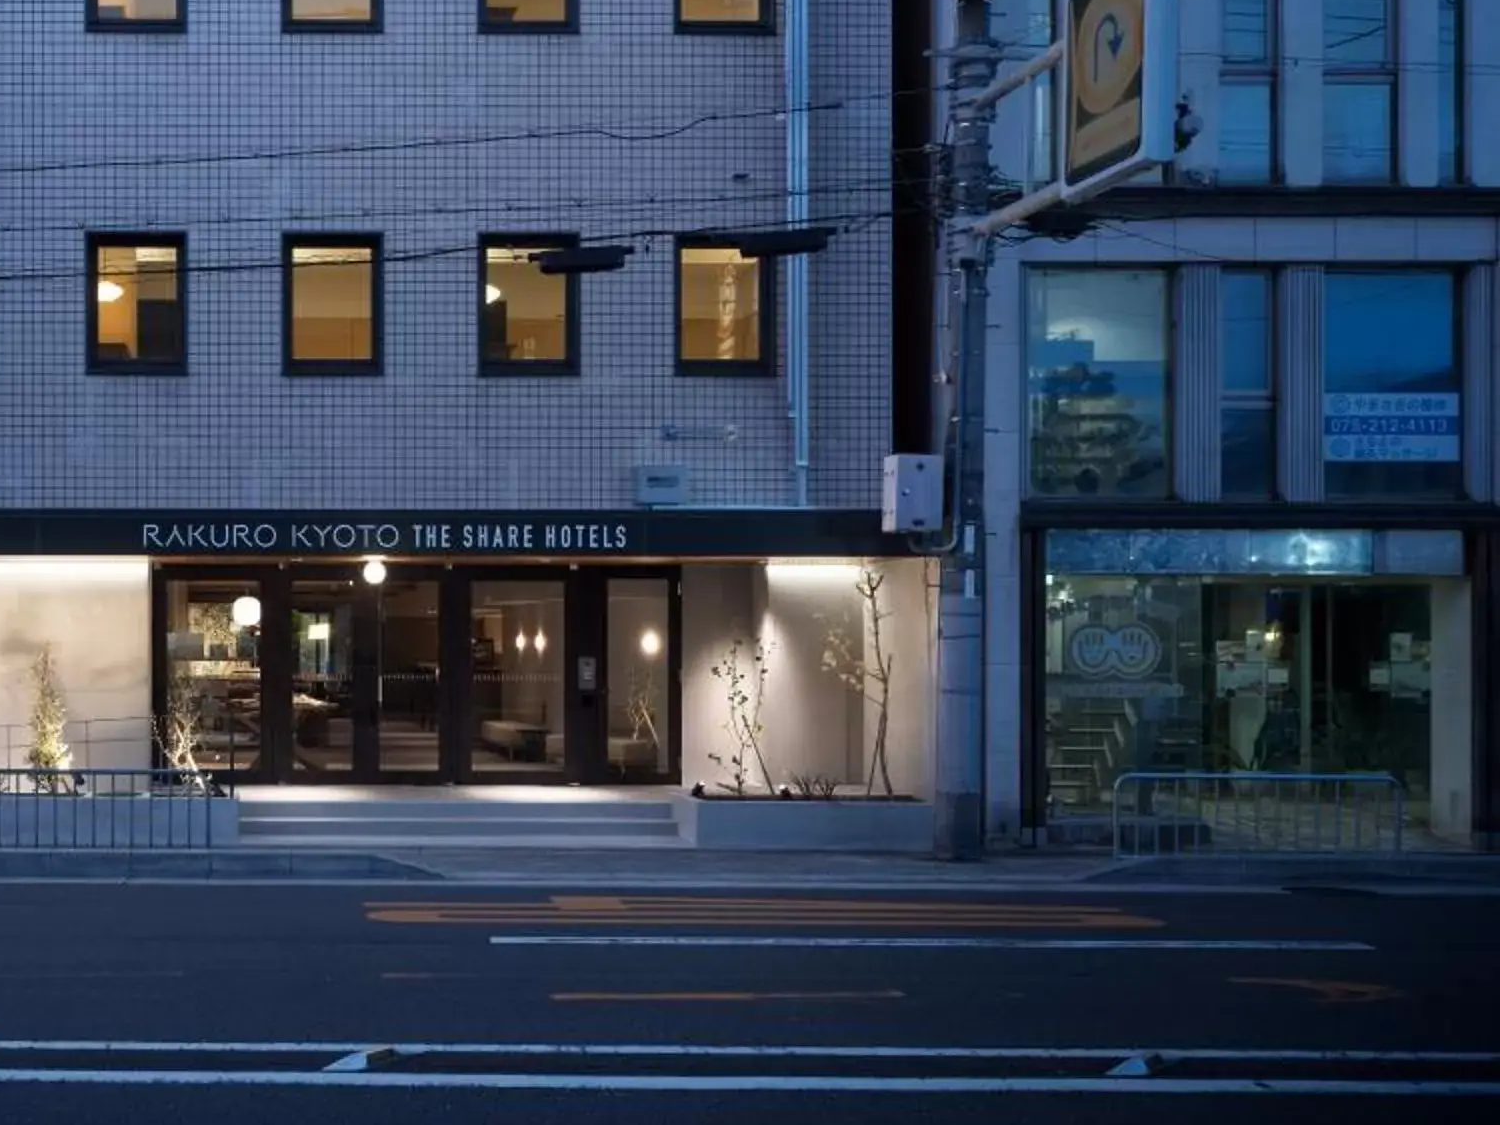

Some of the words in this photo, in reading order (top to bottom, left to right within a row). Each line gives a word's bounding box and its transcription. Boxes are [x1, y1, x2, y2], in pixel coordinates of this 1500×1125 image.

[142, 524, 277, 548] RAKURO
[291, 524, 399, 548] KYOTO
[413, 525, 451, 548] THE
[462, 525, 533, 548] SHARE
[545, 525, 627, 548] HOTELS
